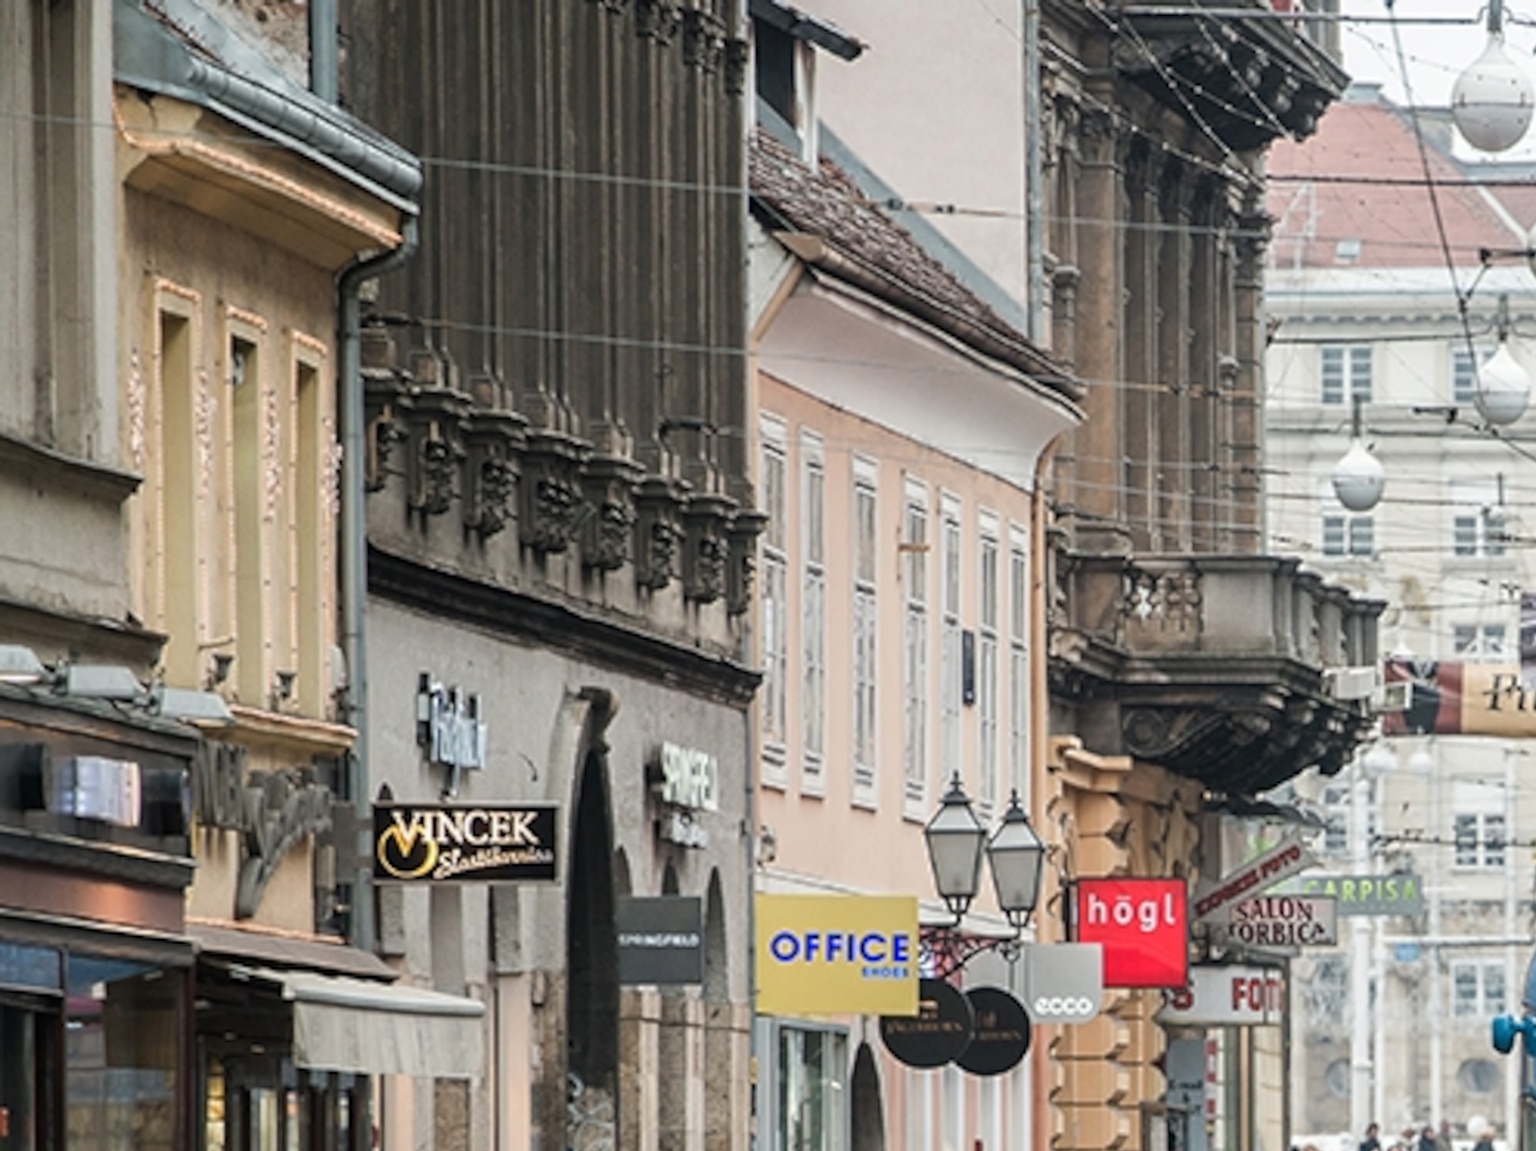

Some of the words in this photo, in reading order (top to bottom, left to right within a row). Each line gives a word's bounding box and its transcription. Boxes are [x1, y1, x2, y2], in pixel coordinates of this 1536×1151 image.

[391, 808, 539, 857] VINCEK
[1303, 880, 1417, 902] CARPISA
[1235, 897, 1312, 921] SALON
[770, 931, 909, 962] OFFICE
[861, 966, 908, 978] SHOES
[1035, 998, 1093, 1014] ecco
